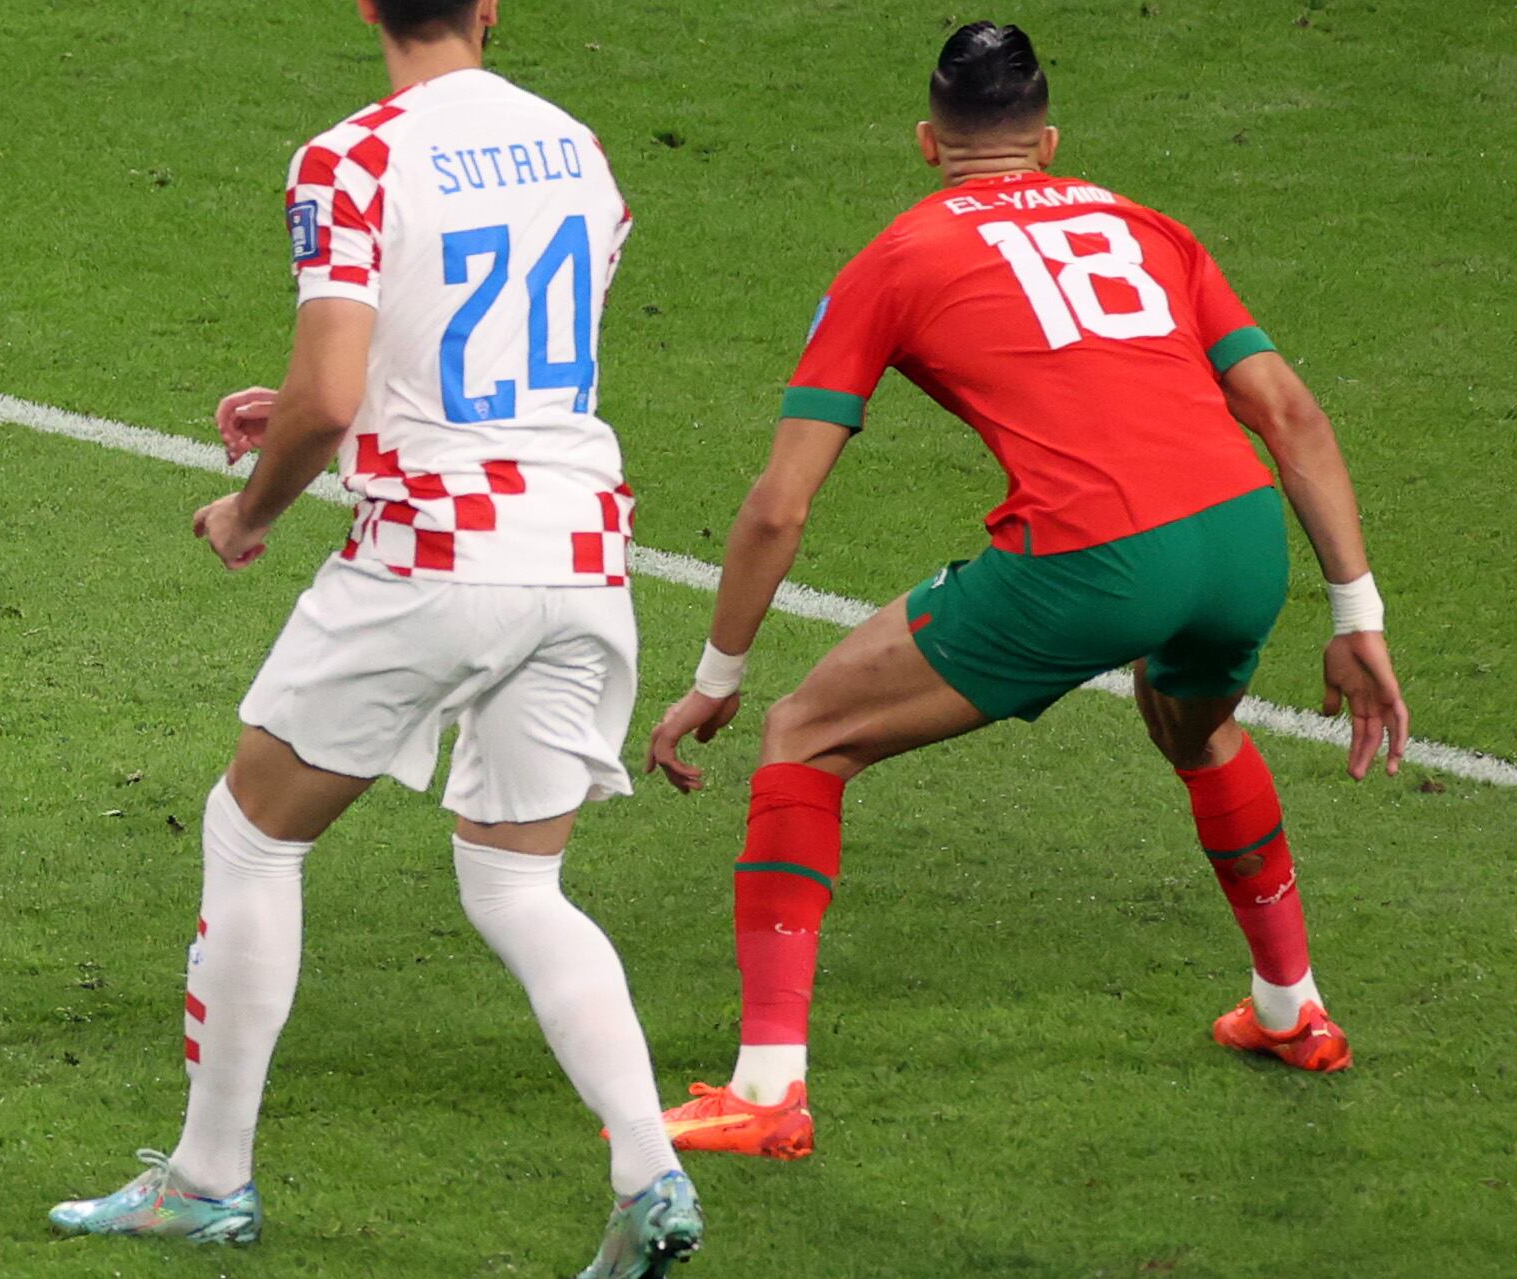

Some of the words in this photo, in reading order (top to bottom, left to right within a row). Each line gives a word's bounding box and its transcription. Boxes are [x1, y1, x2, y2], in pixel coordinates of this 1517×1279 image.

[431, 138, 583, 195] ŠUTALO
[440, 214, 595, 423] 24
[977, 212, 1178, 350] 18
